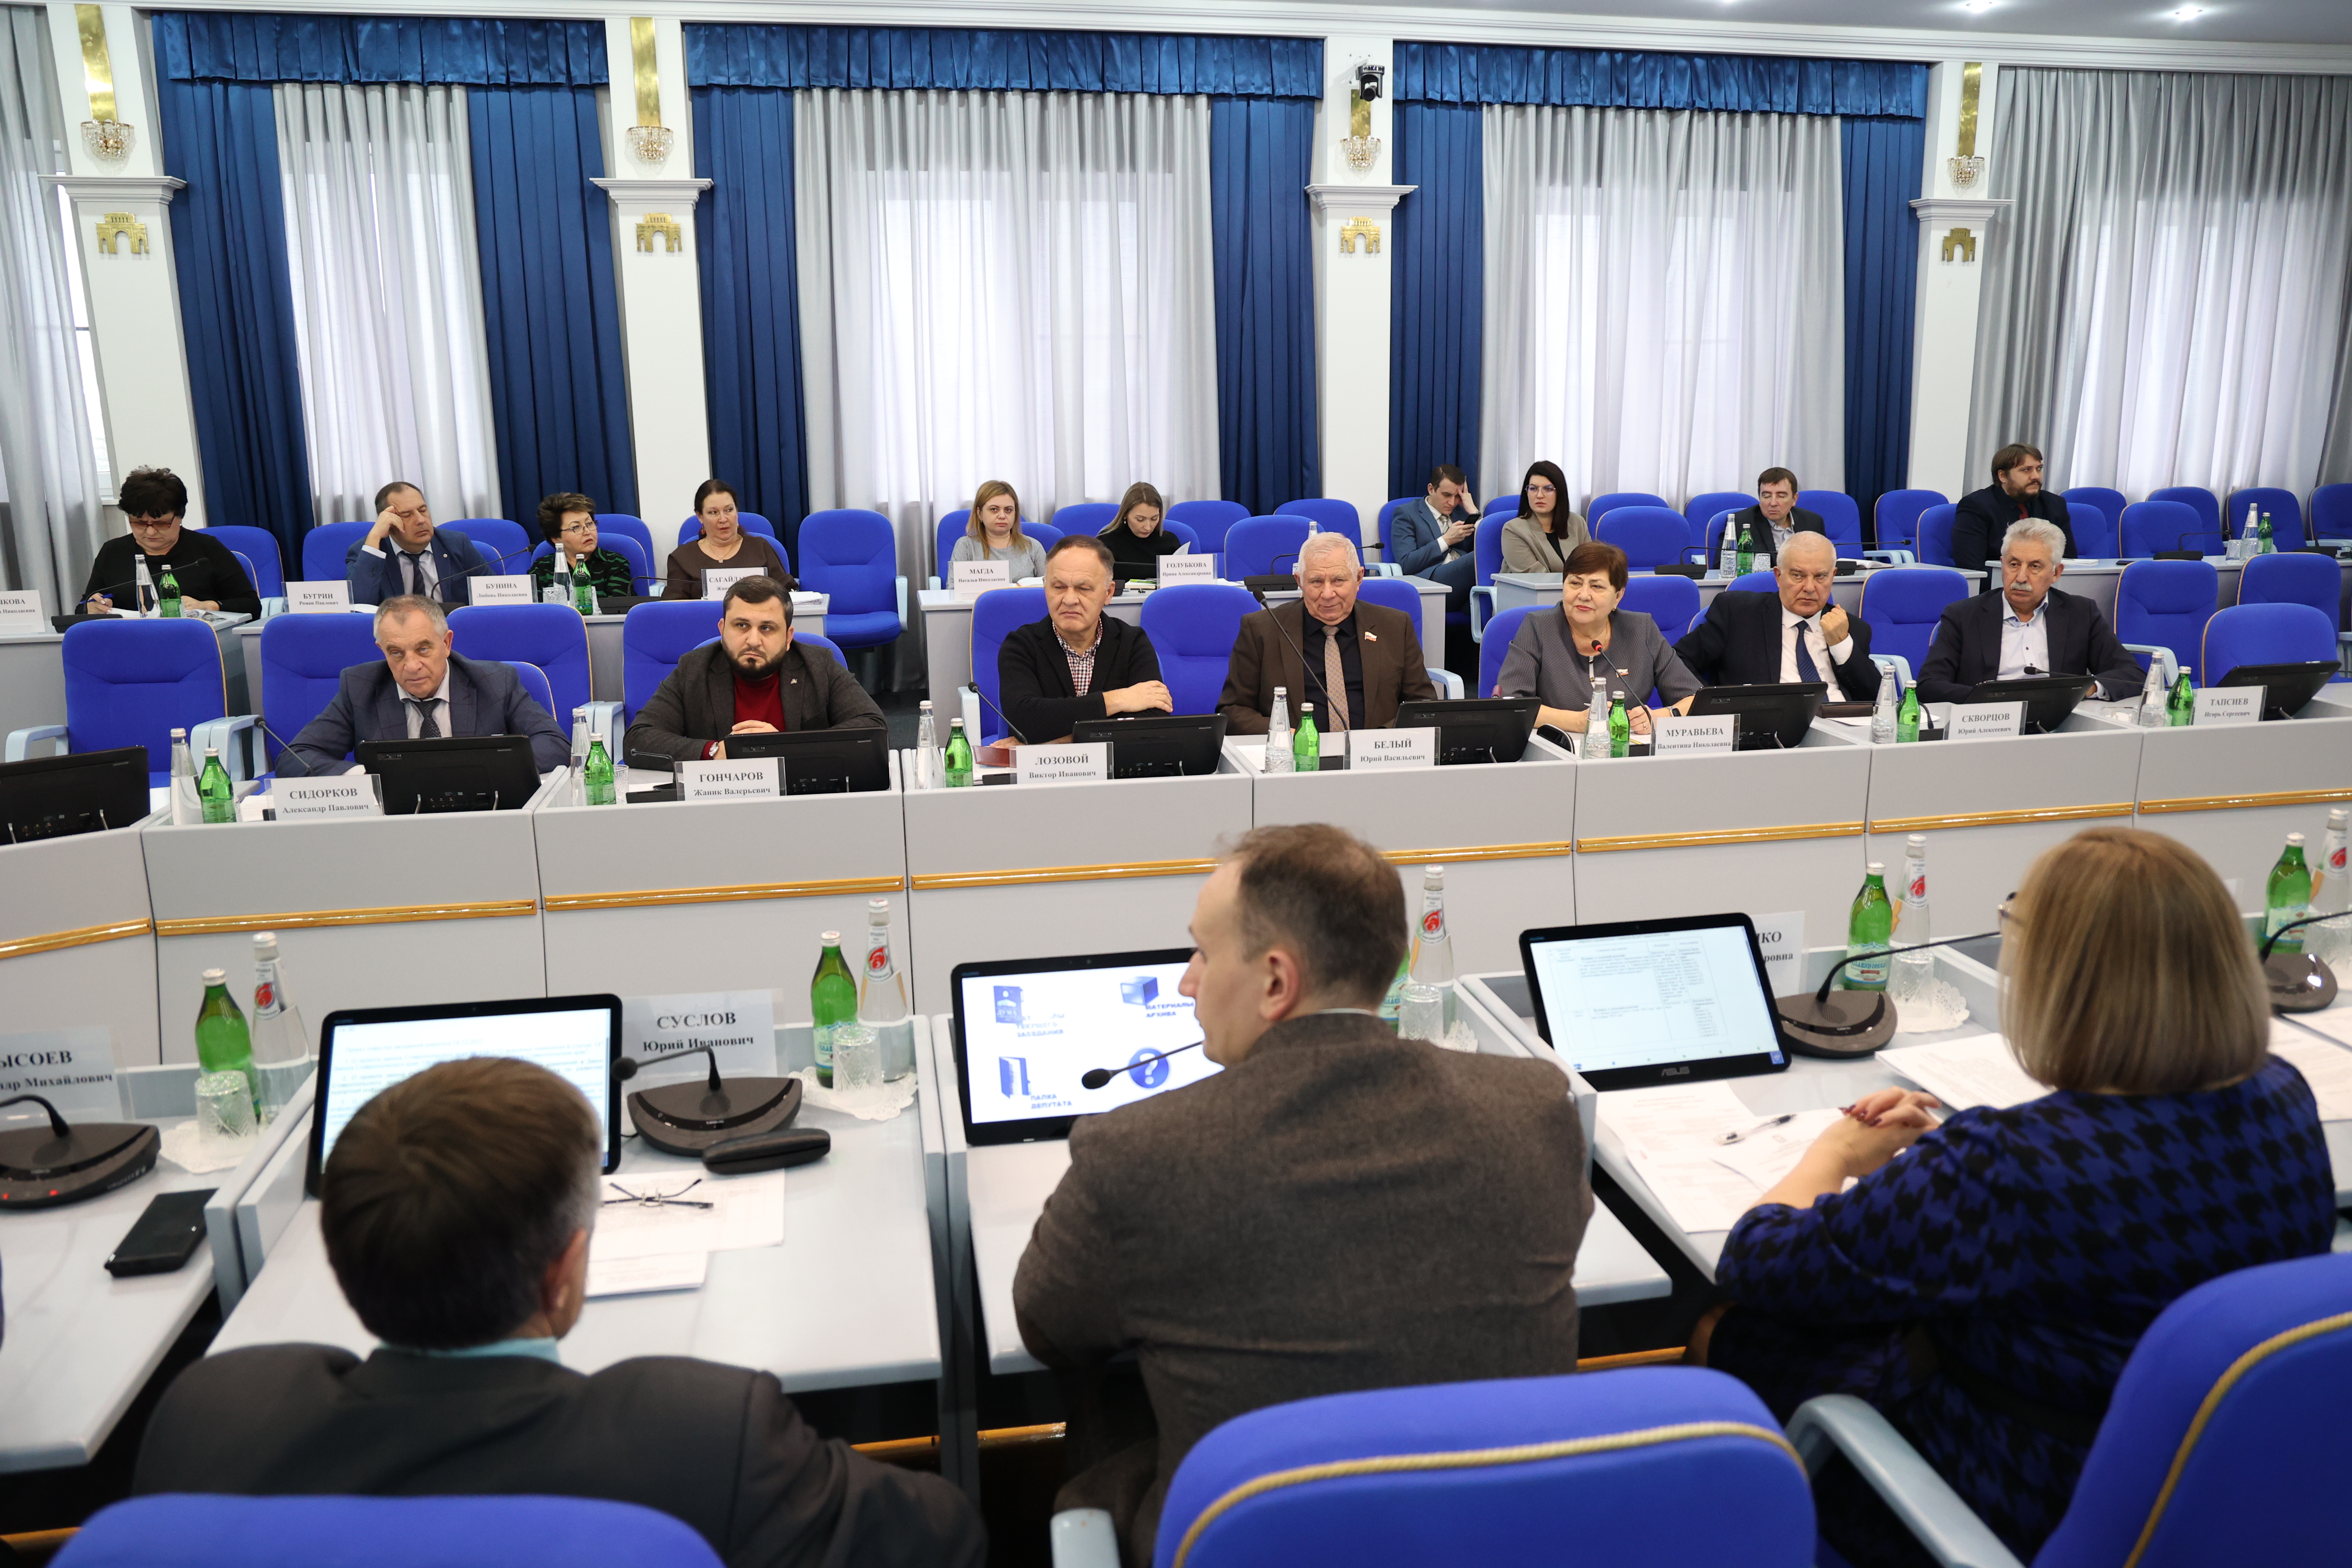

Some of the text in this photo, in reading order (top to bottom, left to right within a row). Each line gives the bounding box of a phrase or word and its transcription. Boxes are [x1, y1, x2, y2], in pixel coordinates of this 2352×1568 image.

[1962, 713, 2010, 722] СКВОРЦОВ
[1666, 728, 1724, 737] МУРАВЬЕВА
[1374, 738, 1412, 749] БЕЛЫЙ
[1035, 753, 1089, 765] ЛОЗОВОЙ
[699, 772, 763, 782] ГОНЧАРОВ
[290, 788, 358, 800] СИДОРКОВ
[657, 1012, 736, 1029] СУСЛОВ
[643, 1036, 753, 1053] Юрий Иванович
[24, 1074, 112, 1088] Михайлович
